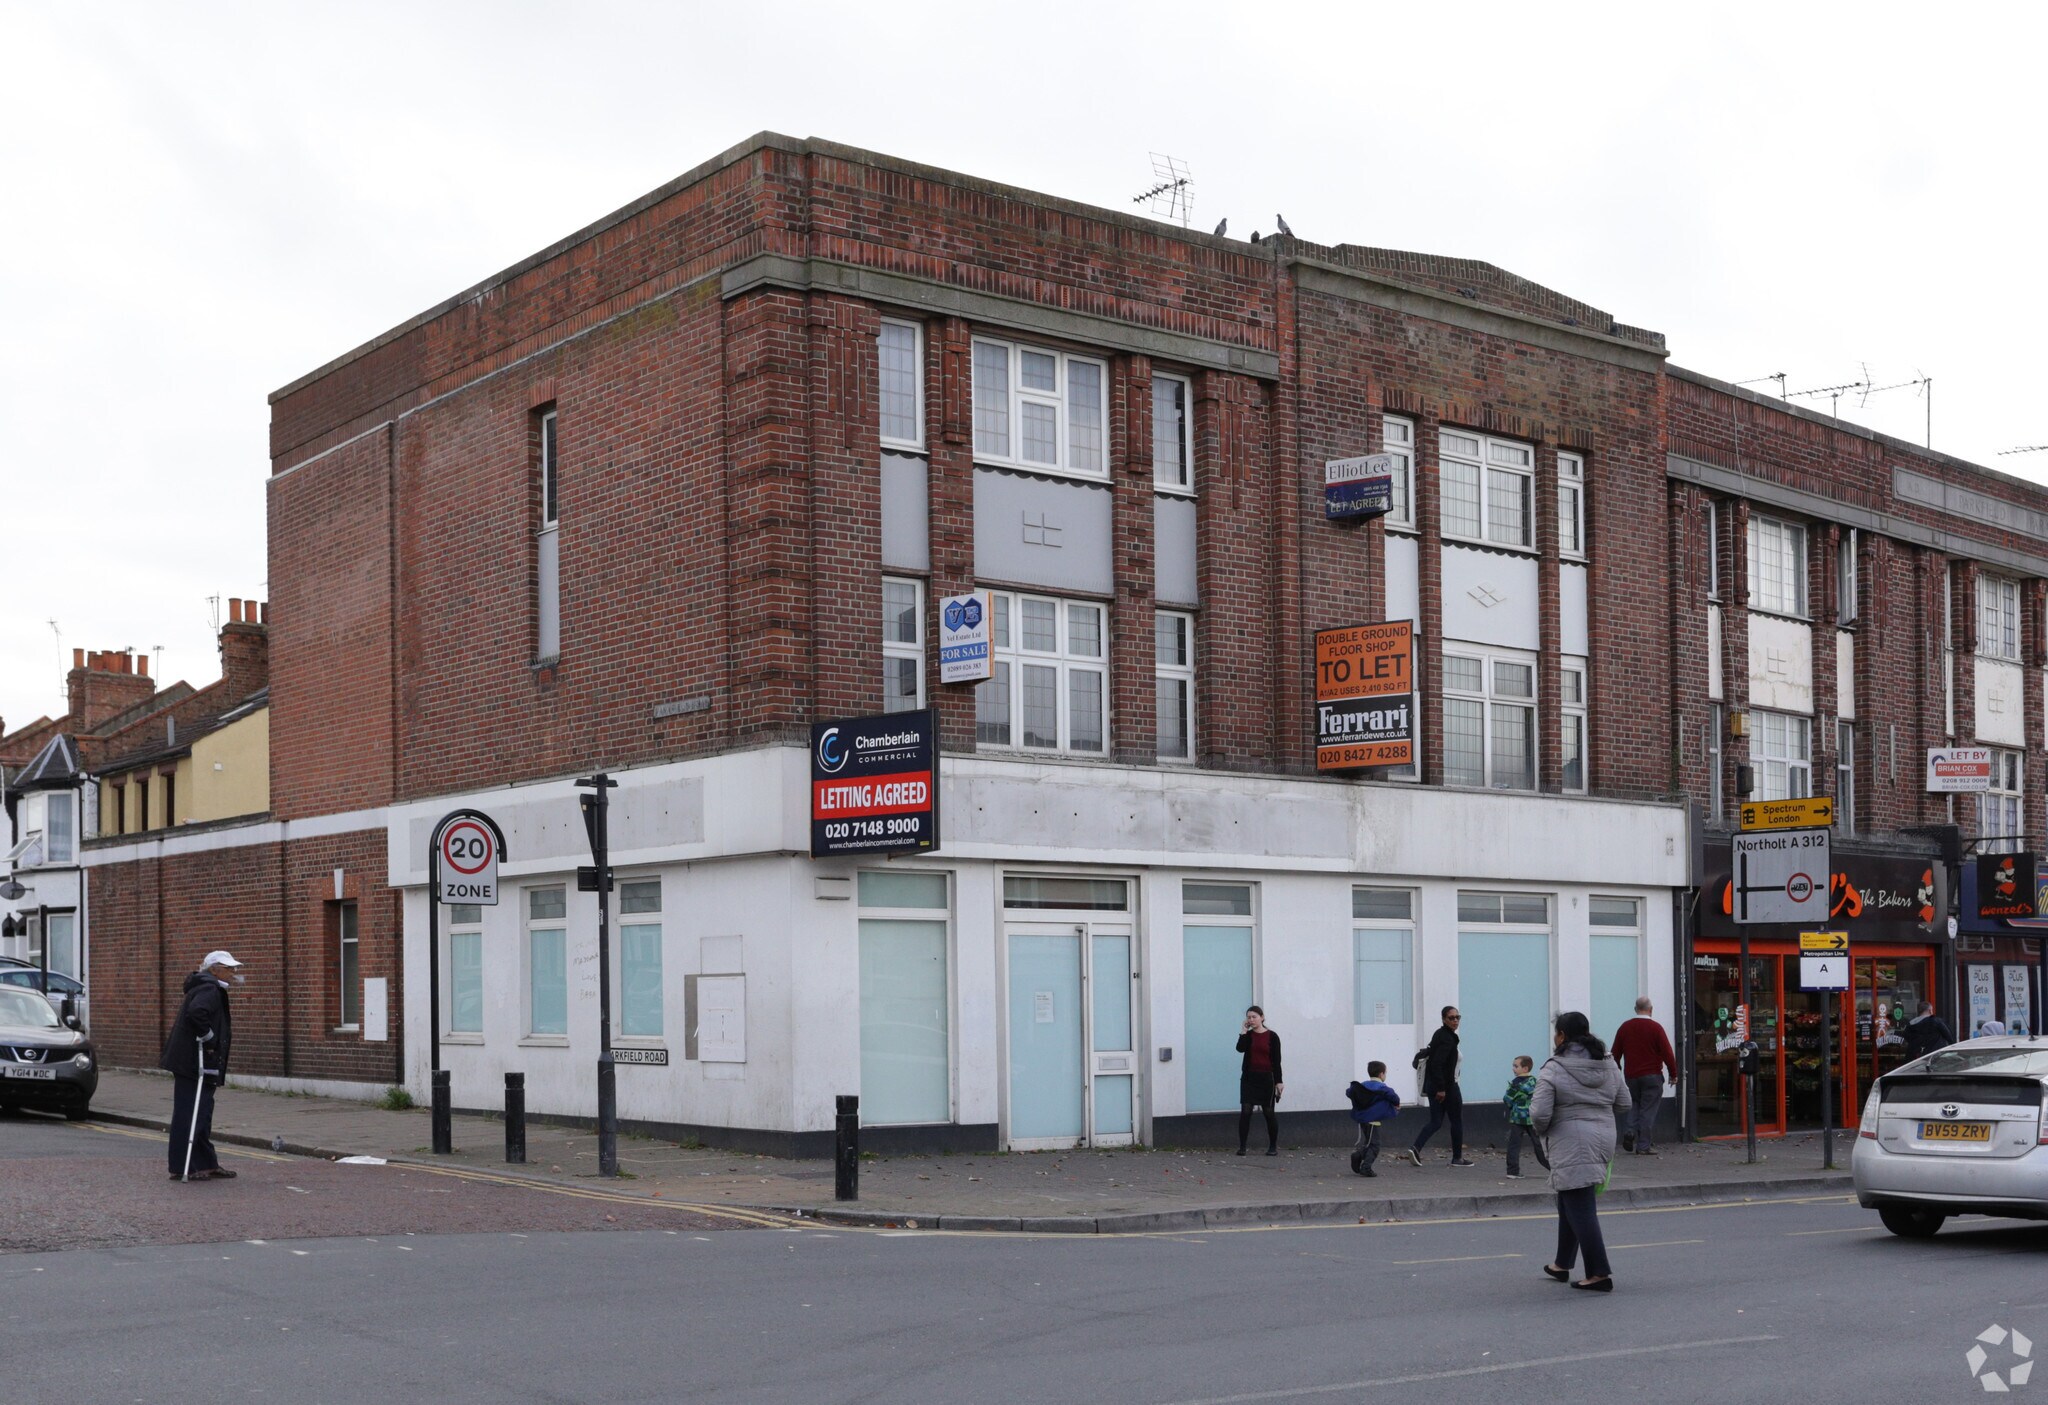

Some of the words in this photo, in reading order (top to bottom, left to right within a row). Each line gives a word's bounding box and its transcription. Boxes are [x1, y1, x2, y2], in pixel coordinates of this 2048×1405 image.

[1330, 501, 1348, 513] LET
[1349, 497, 1384, 511] AGREE
[1960, 495, 2006, 519] PARKFIELD
[956, 633, 971, 641] Estate
[972, 631, 981, 639] Ltd
[1319, 631, 1358, 646] DOUBLE
[1361, 626, 1408, 641] GROUND
[941, 648, 960, 660] FOR
[962, 644, 987, 657] SALE
[1329, 644, 1363, 657] FLOOR
[1365, 640, 1396, 653] SHOP
[1320, 659, 1351, 684] TO
[1360, 653, 1406, 680] LET
[1319, 688, 1338, 697] A1/A2
[1340, 685, 1360, 695] USES
[1362, 684, 1382, 694] 2,410
[1383, 682, 1395, 690] SQ
[1397, 681, 1407, 690] FT
[1318, 703, 1408, 736] Ferrari
[855, 731, 920, 749] Chamberlain
[1321, 729, 1407, 743] www.ferraridewe.co.uk
[858, 752, 917, 764] COMMERCIAL
[1320, 751, 1341, 764] 020
[1344, 747, 1373, 762] 8427
[1377, 745, 1408, 759] 4288
[1951, 751, 1969, 760] LET
[1973, 751, 1987, 760] BY
[820, 784, 871, 810] LETTING
[874, 781, 927, 807] AGREED
[1763, 804, 1805, 815] Spectrum
[1768, 815, 1800, 824] London
[825, 823, 849, 839] 020
[852, 820, 884, 837] 7148
[887, 817, 919, 834] 9000
[451, 837, 485, 859] 20
[829, 837, 915, 849] www.chamberlaincommercial.com
[1737, 838, 1786, 851] Northolt
[1790, 837, 1799, 848] A
[1802, 835, 1824, 848] 312
[447, 884, 491, 898] ZONE
[1860, 888, 1875, 907] The
[1878, 889, 1912, 908] Bakers
[1694, 955, 1719, 966] LAVAZZA
[1728, 967, 1757, 979] FRH
[1820, 964, 1828, 973] A
[1974, 985, 1984, 994] Get
[1984, 986, 1989, 994] a
[610, 1050, 643, 1062] ARKFIELD
[644, 1051, 666, 1063] ROAD
[11, 1068, 31, 1077] YG14
[33, 1069, 50, 1078] WDC
[1925, 1124, 1959, 1137] BV59
[1961, 1125, 1989, 1138] ZRY
